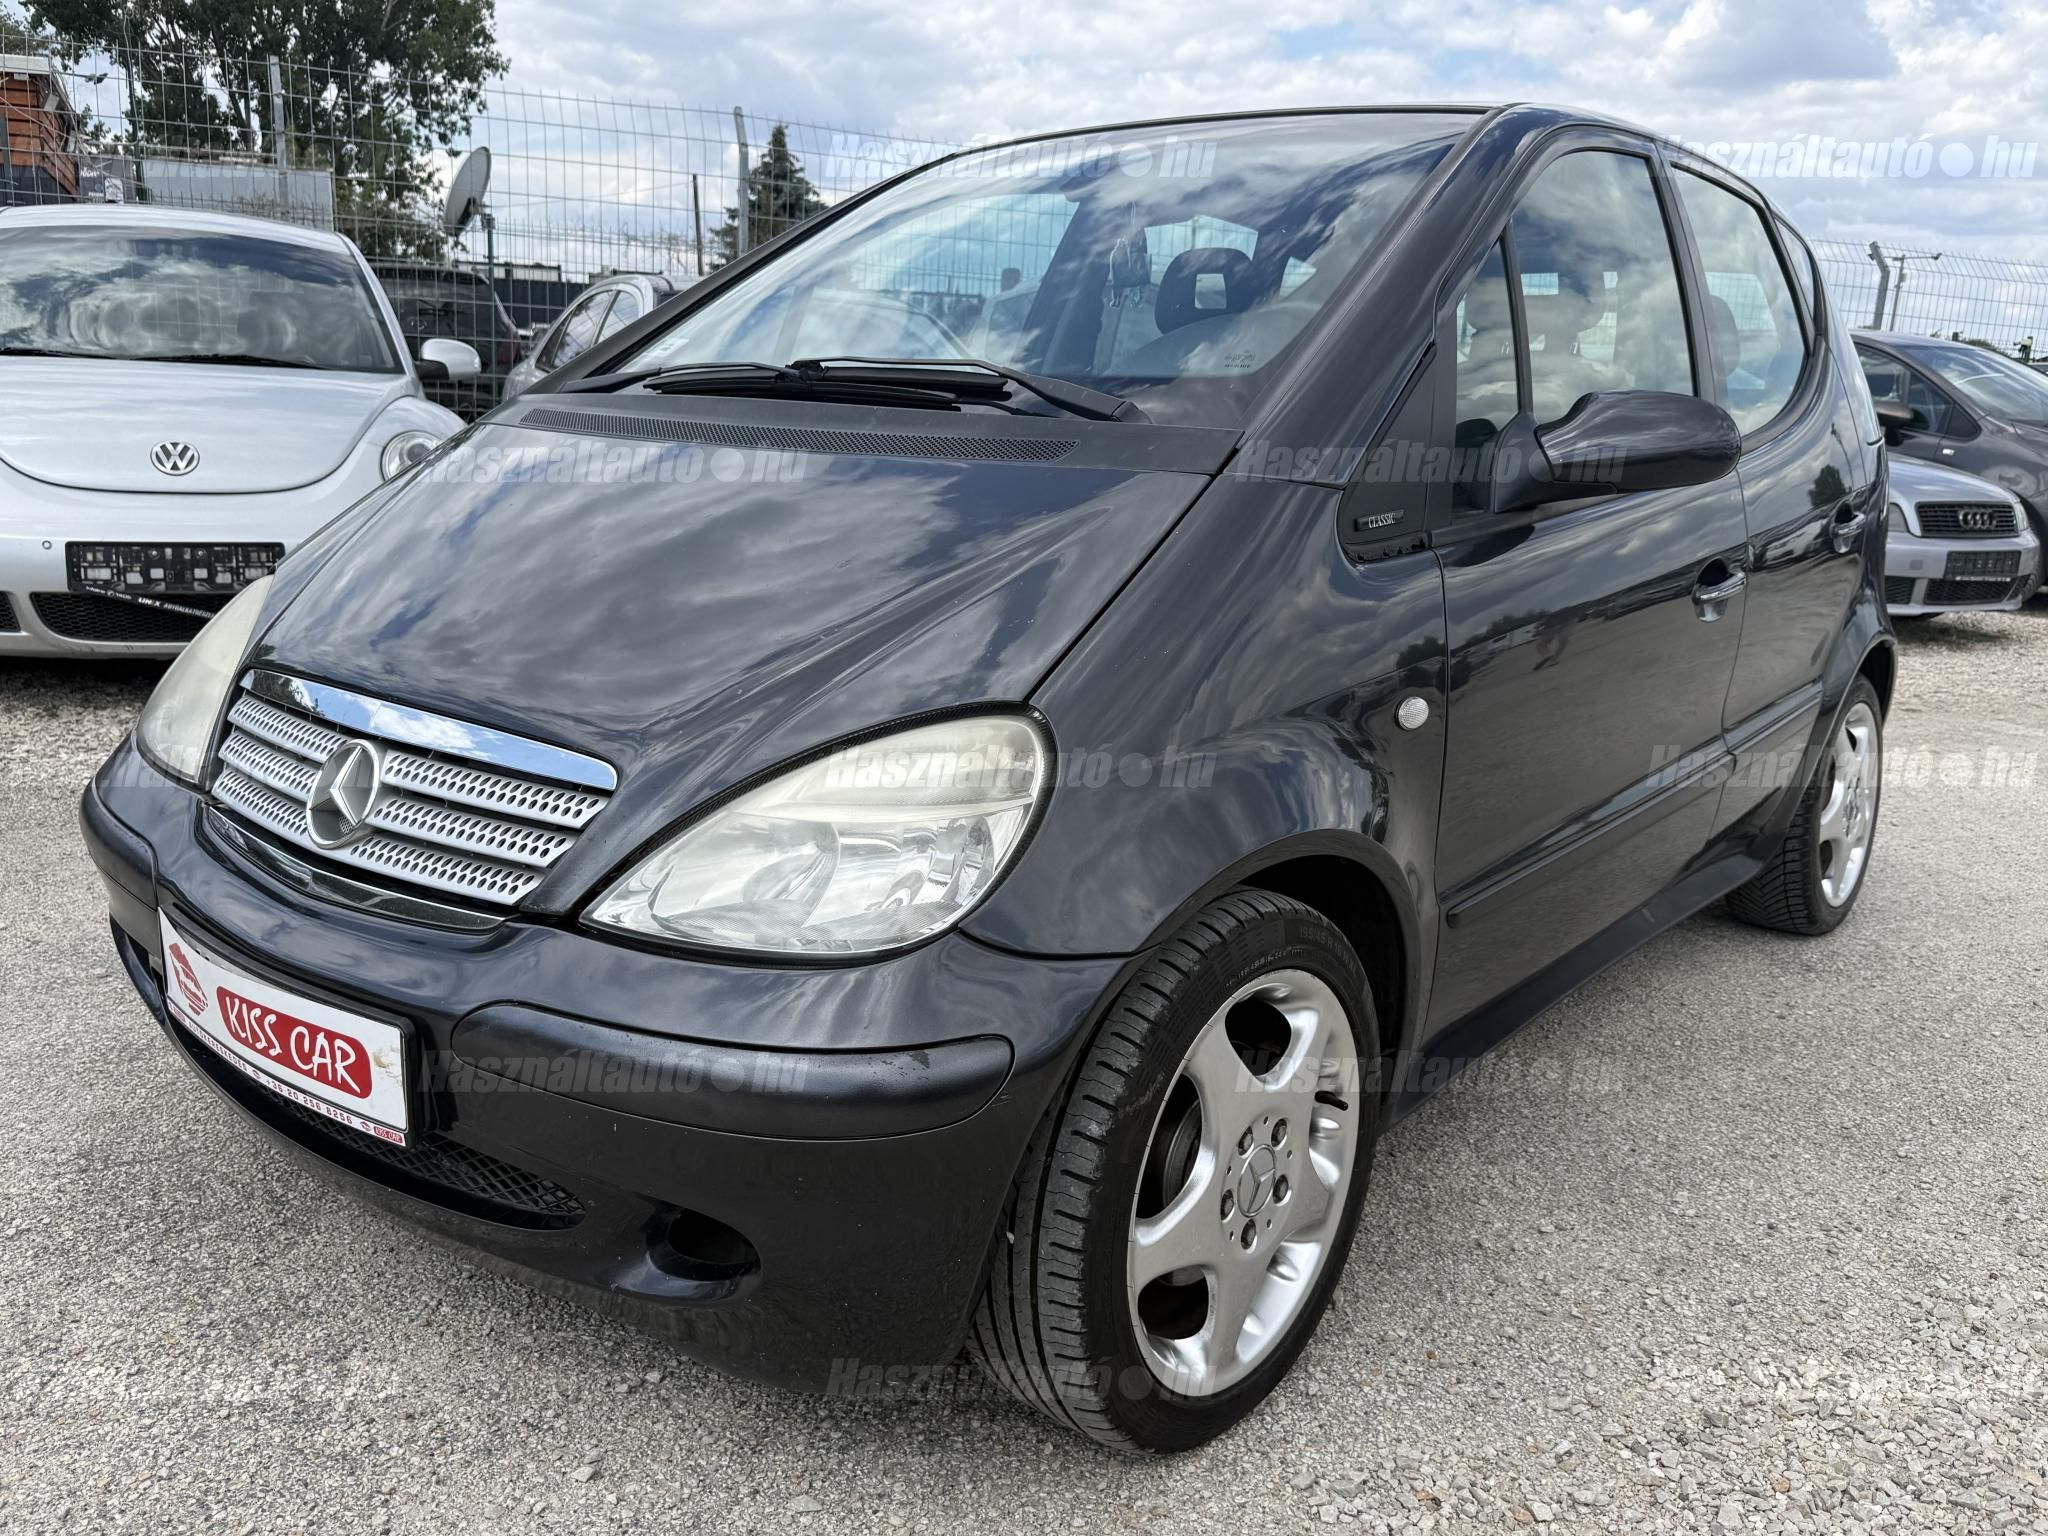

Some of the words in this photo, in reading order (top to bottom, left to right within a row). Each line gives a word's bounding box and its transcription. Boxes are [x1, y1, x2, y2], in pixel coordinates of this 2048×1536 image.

[1368, 512, 1395, 528] CLASSIC
[225, 995, 283, 1057] KISS
[289, 1026, 361, 1094] CAR
[287, 1088, 299, 1101] 20
[303, 1096, 321, 1111] 256
[326, 1107, 353, 1125] 8256
